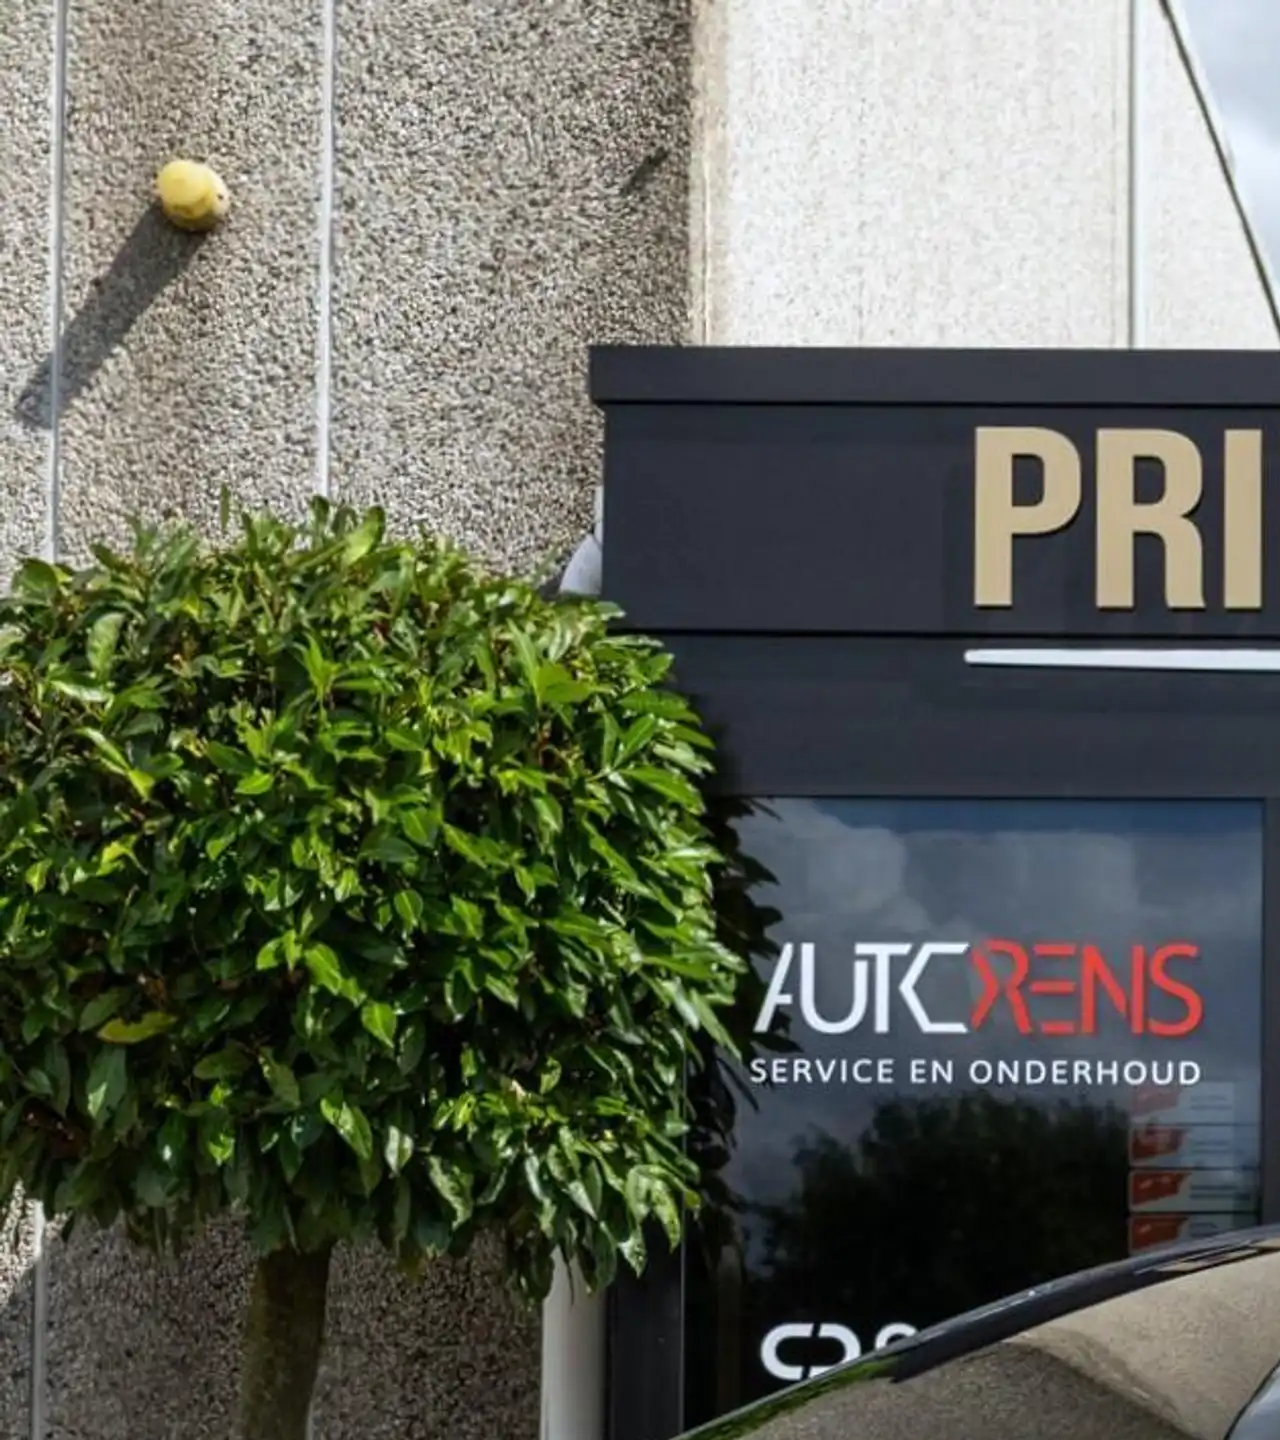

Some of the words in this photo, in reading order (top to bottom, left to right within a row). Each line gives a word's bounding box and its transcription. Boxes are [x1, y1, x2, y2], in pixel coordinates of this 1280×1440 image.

[749, 1058, 894, 1085] SERVICE
[910, 1059, 954, 1085] EN
[969, 1060, 1201, 1086] ONDERHOUD
